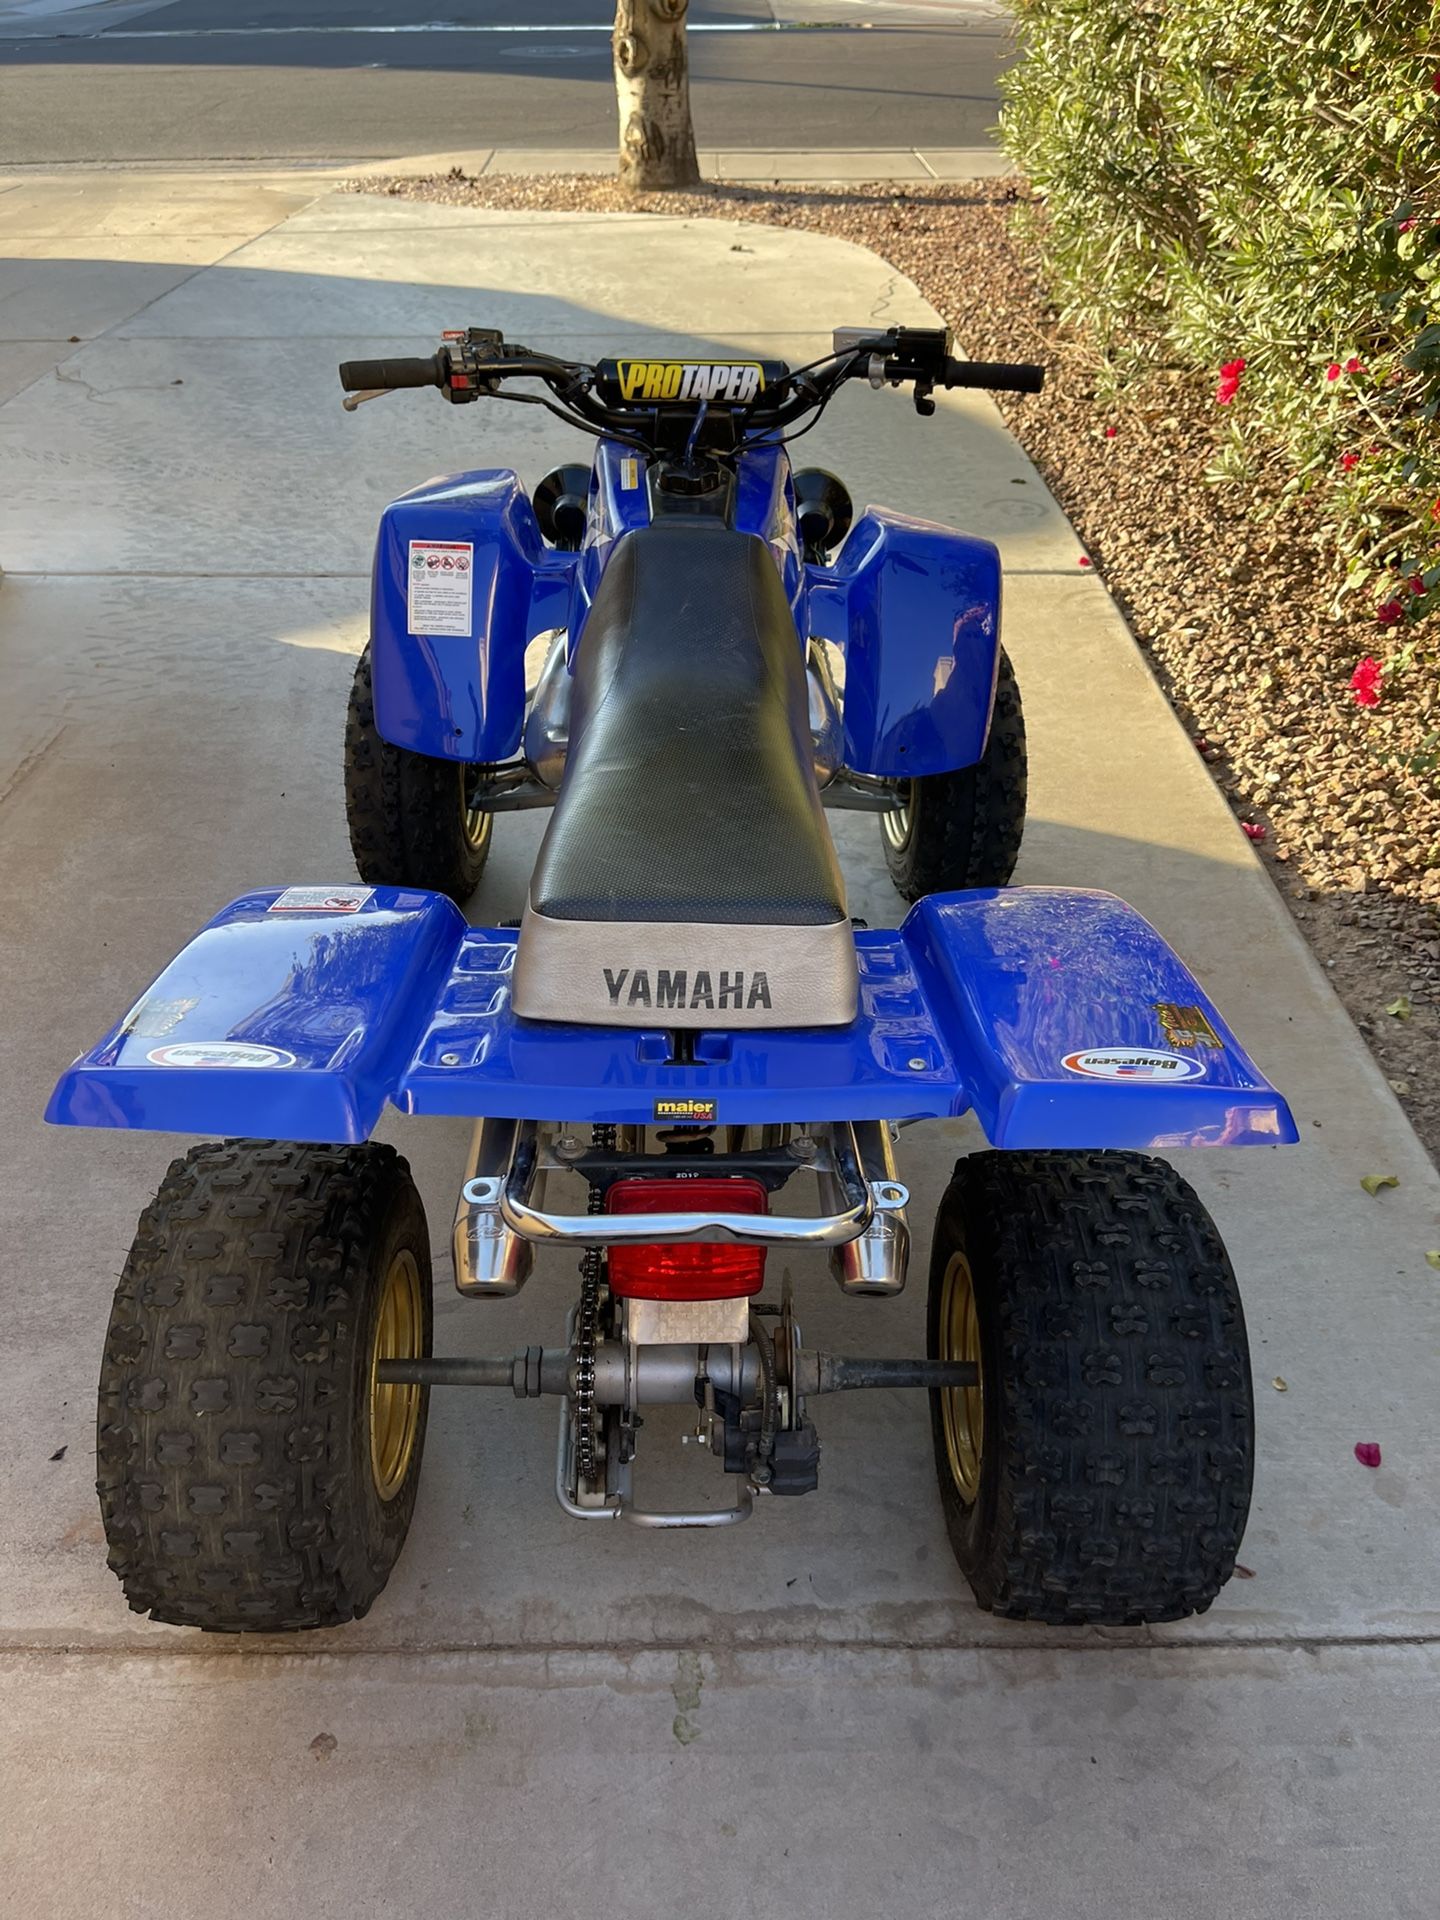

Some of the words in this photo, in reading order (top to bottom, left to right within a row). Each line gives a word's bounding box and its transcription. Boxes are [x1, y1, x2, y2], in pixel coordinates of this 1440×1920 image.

[627, 363, 760, 400] PROTAPER
[603, 968, 772, 1009] YAMAHA
[1084, 1057, 1179, 1069] Boyesen
[657, 1100, 713, 1112] maier
[693, 1112, 713, 1120] USA
